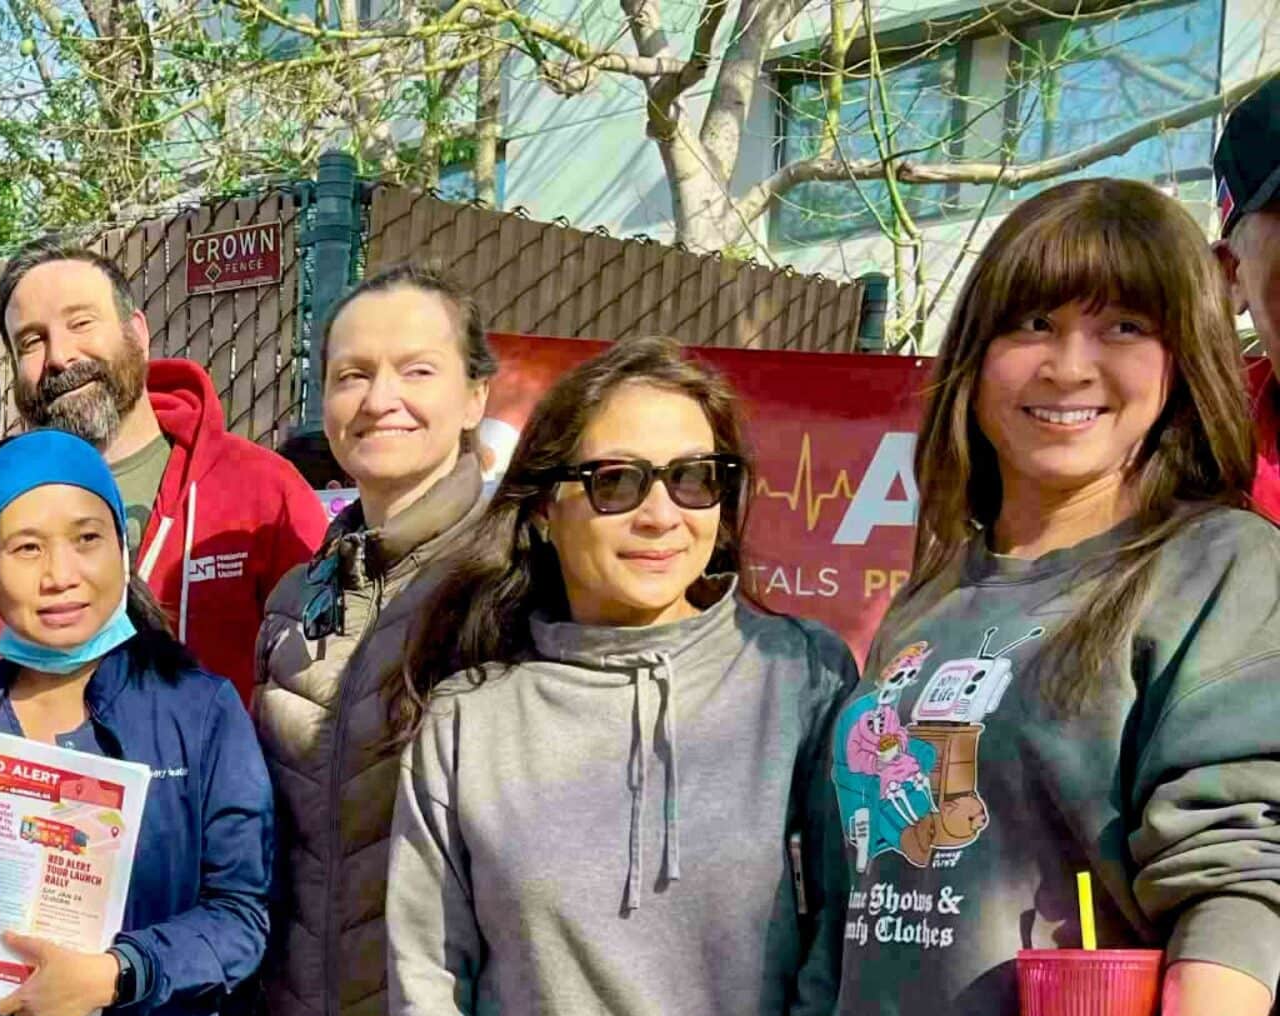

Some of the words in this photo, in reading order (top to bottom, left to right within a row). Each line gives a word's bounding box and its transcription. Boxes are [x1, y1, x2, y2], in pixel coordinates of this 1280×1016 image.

[193, 228, 274, 264] CROWN
[225, 259, 264, 273] FENCE
[12, 765, 60, 784] ALERT
[48, 854, 64, 866] RED
[66, 858, 91, 872] ALERT
[45, 875, 69, 888] RALLY
[47, 864, 68, 877] TOUR
[70, 870, 102, 886] LAUNCH
[868, 882, 933, 915] Shows
[937, 886, 964, 914] &
[875, 916, 954, 948] Clothes
